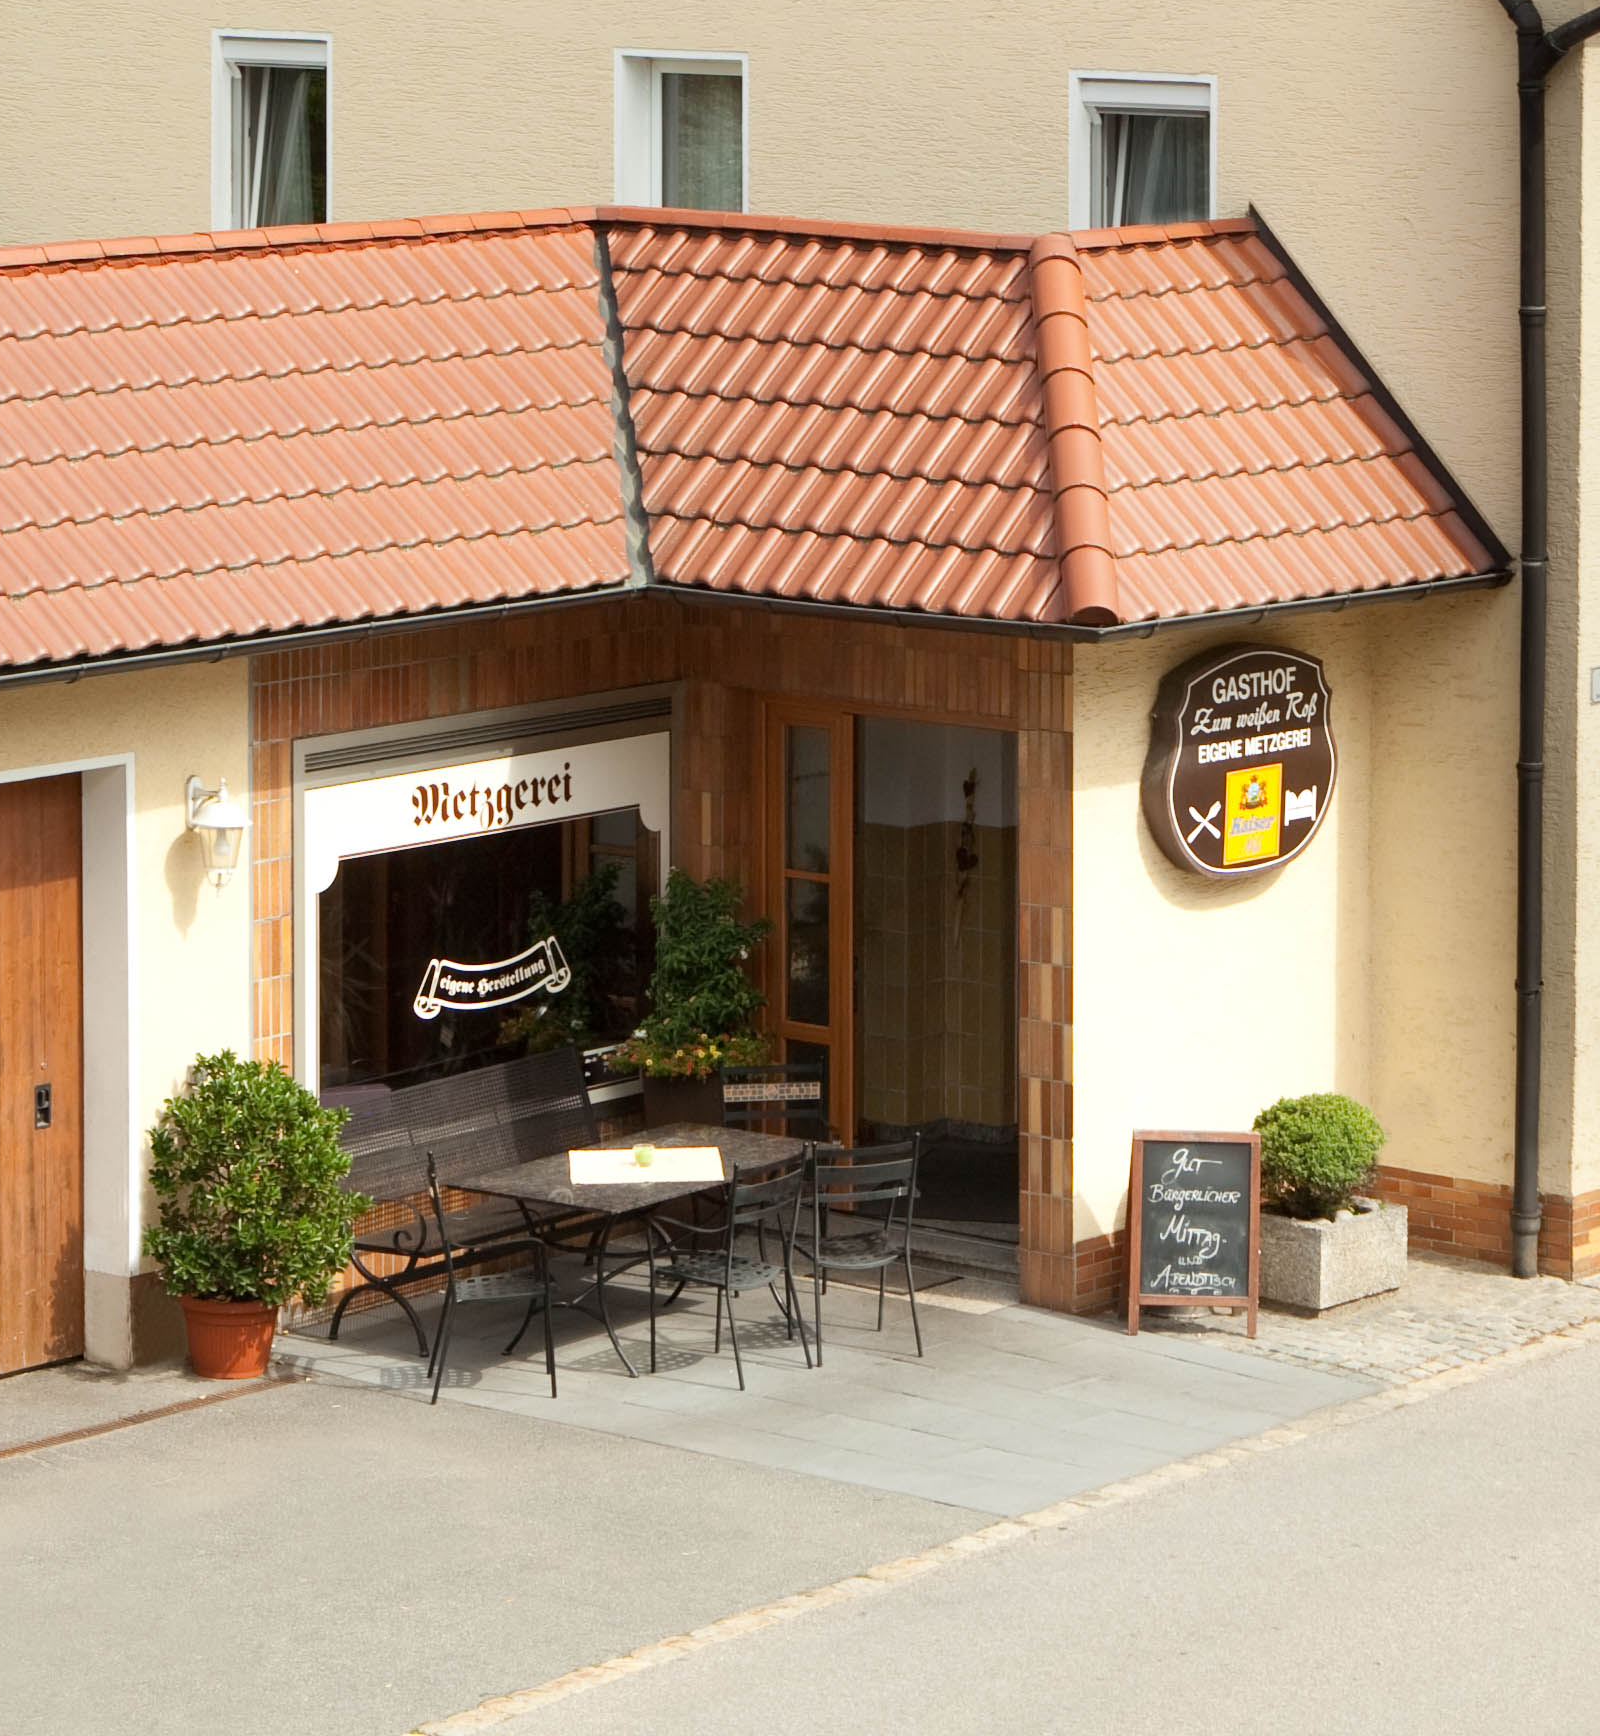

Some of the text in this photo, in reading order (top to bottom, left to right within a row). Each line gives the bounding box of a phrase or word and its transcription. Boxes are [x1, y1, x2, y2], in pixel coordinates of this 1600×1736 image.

[1212, 666, 1297, 704] GASTHOF
[1190, 691, 1318, 736] Zum weißen Roß
[1198, 727, 1311, 764] EIGENE METZGEREI
[412, 762, 572, 830] Metzgerei
[440, 958, 547, 998] eigene Herstellung
